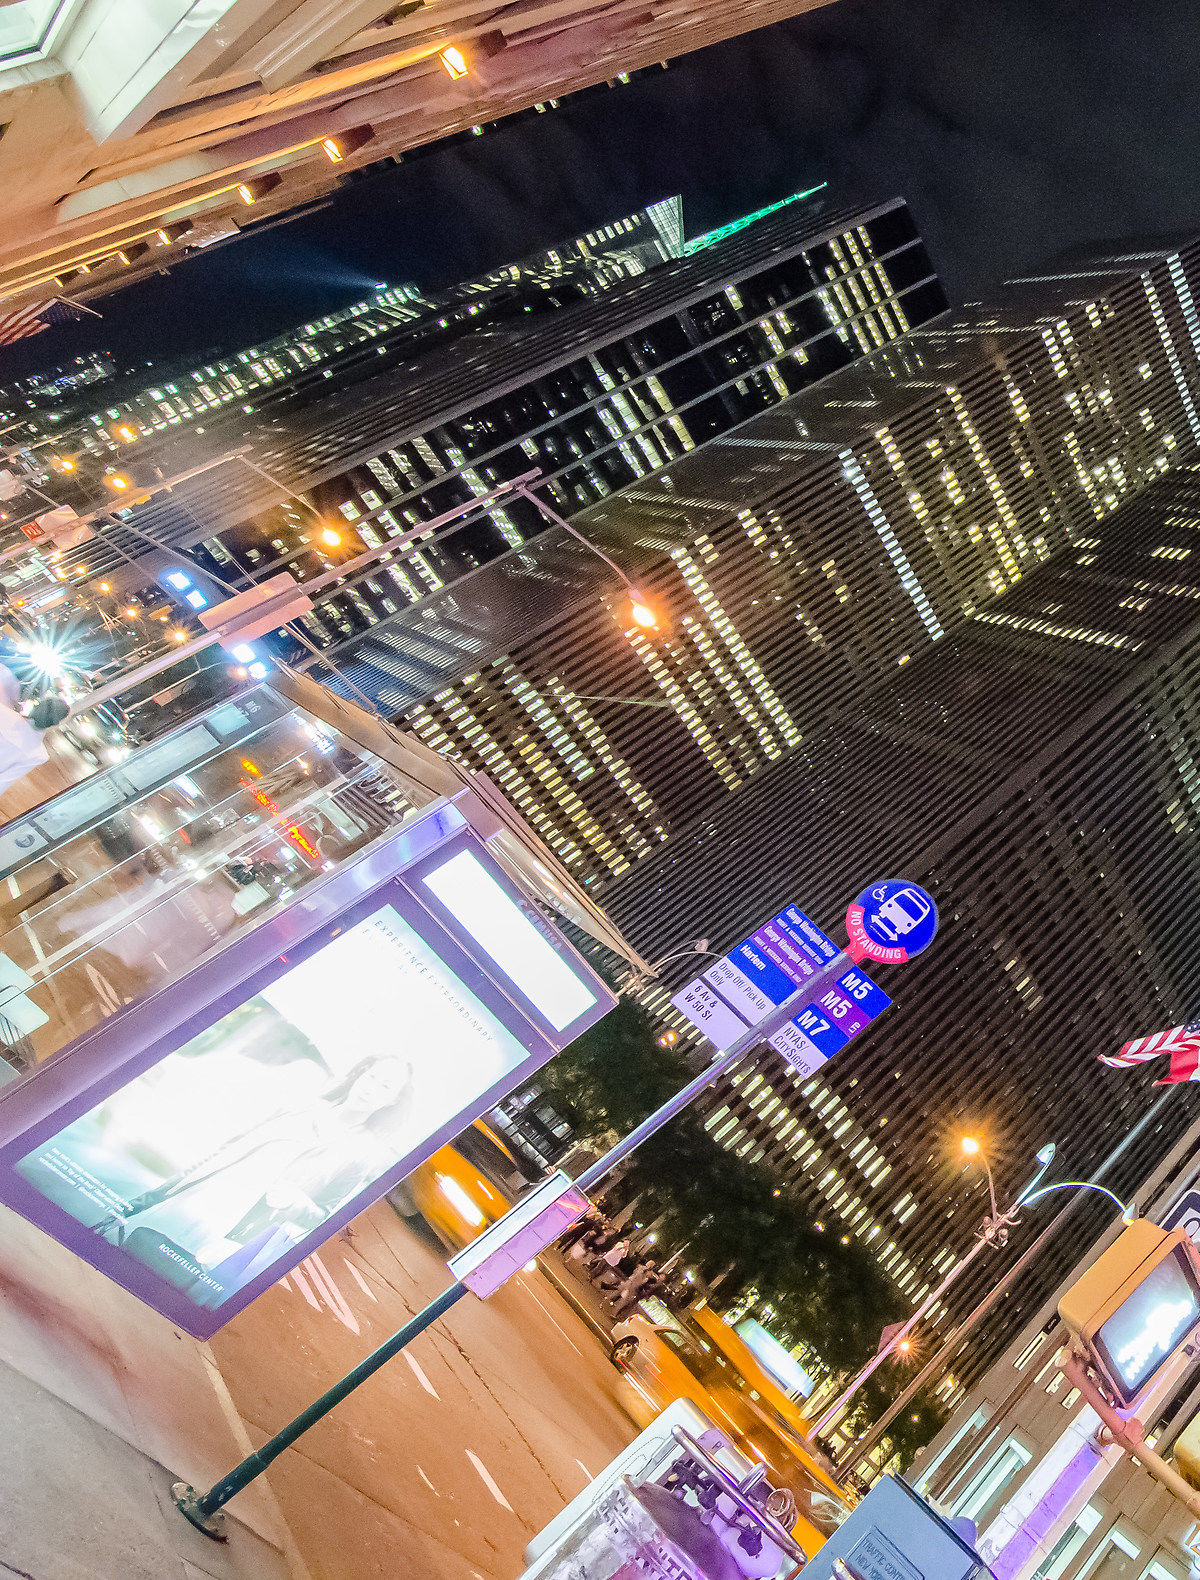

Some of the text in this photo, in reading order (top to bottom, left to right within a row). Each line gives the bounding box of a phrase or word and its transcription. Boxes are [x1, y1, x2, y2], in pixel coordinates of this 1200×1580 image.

[785, 907, 836, 958] George Washington Bridge
[852, 911, 900, 958] NO STANDING
[740, 944, 766, 970] Harlem
[762, 925, 814, 976] George Washington Bridge
[708, 970, 725, 986] Only
[718, 962, 735, 978] Drop
[742, 986, 759, 1002] Pick
[754, 998, 767, 1010] Up
[840, 971, 873, 1001] M5
[684, 992, 713, 1020] W 50 St
[693, 984, 719, 1008] 6 Av &
[819, 989, 860, 1033] M5 LTD
[796, 1009, 830, 1036] M7
[157, 1242, 200, 1276] ROCKEFELLER
